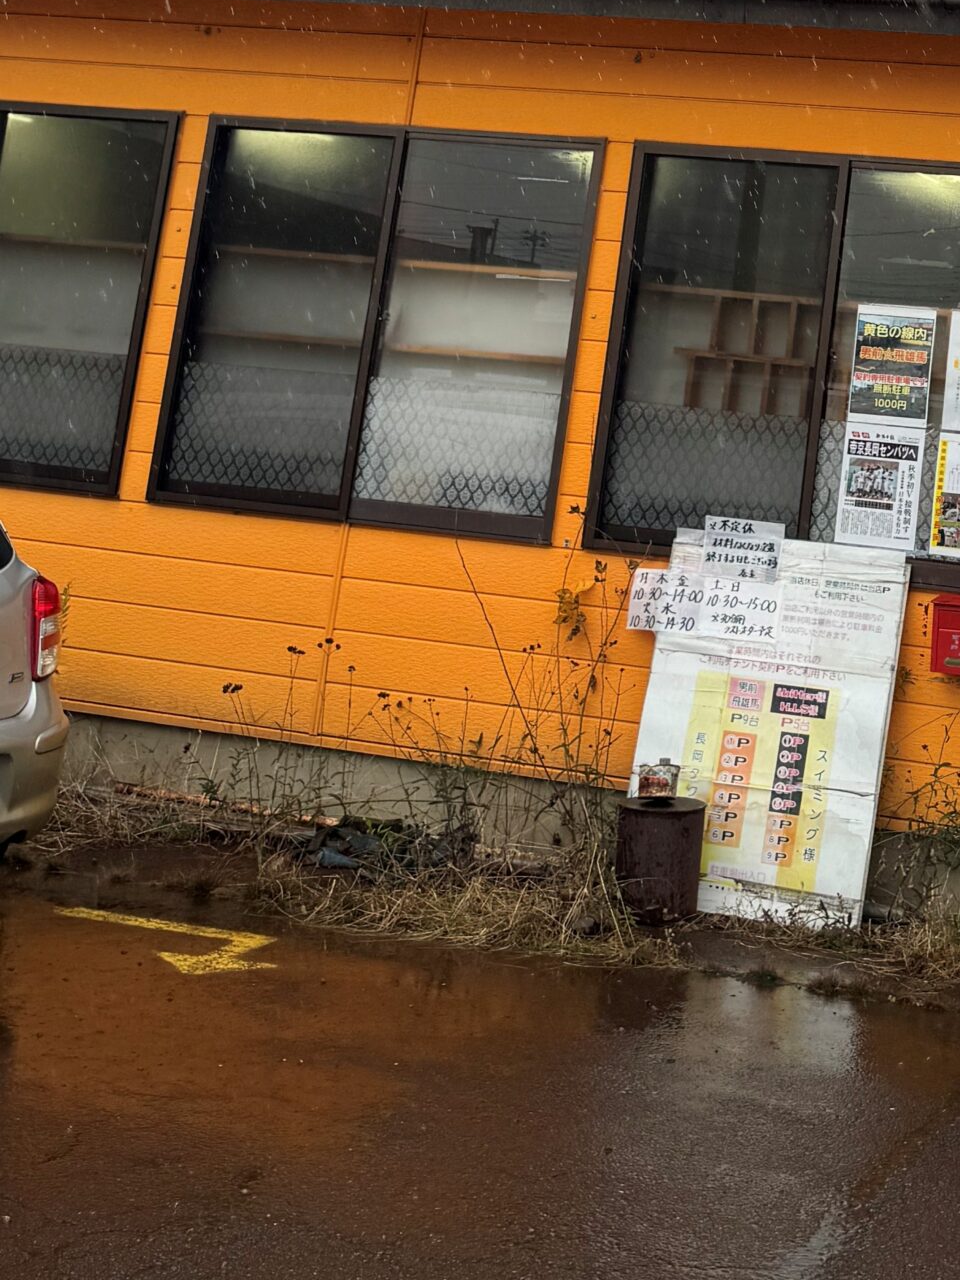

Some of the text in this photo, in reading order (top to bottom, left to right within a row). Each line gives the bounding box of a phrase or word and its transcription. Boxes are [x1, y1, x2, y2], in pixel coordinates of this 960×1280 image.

[864, 323, 927, 340] 黄色の線内
[875, 399, 907, 410] 1000円
[739, 681, 757, 694] 男前
